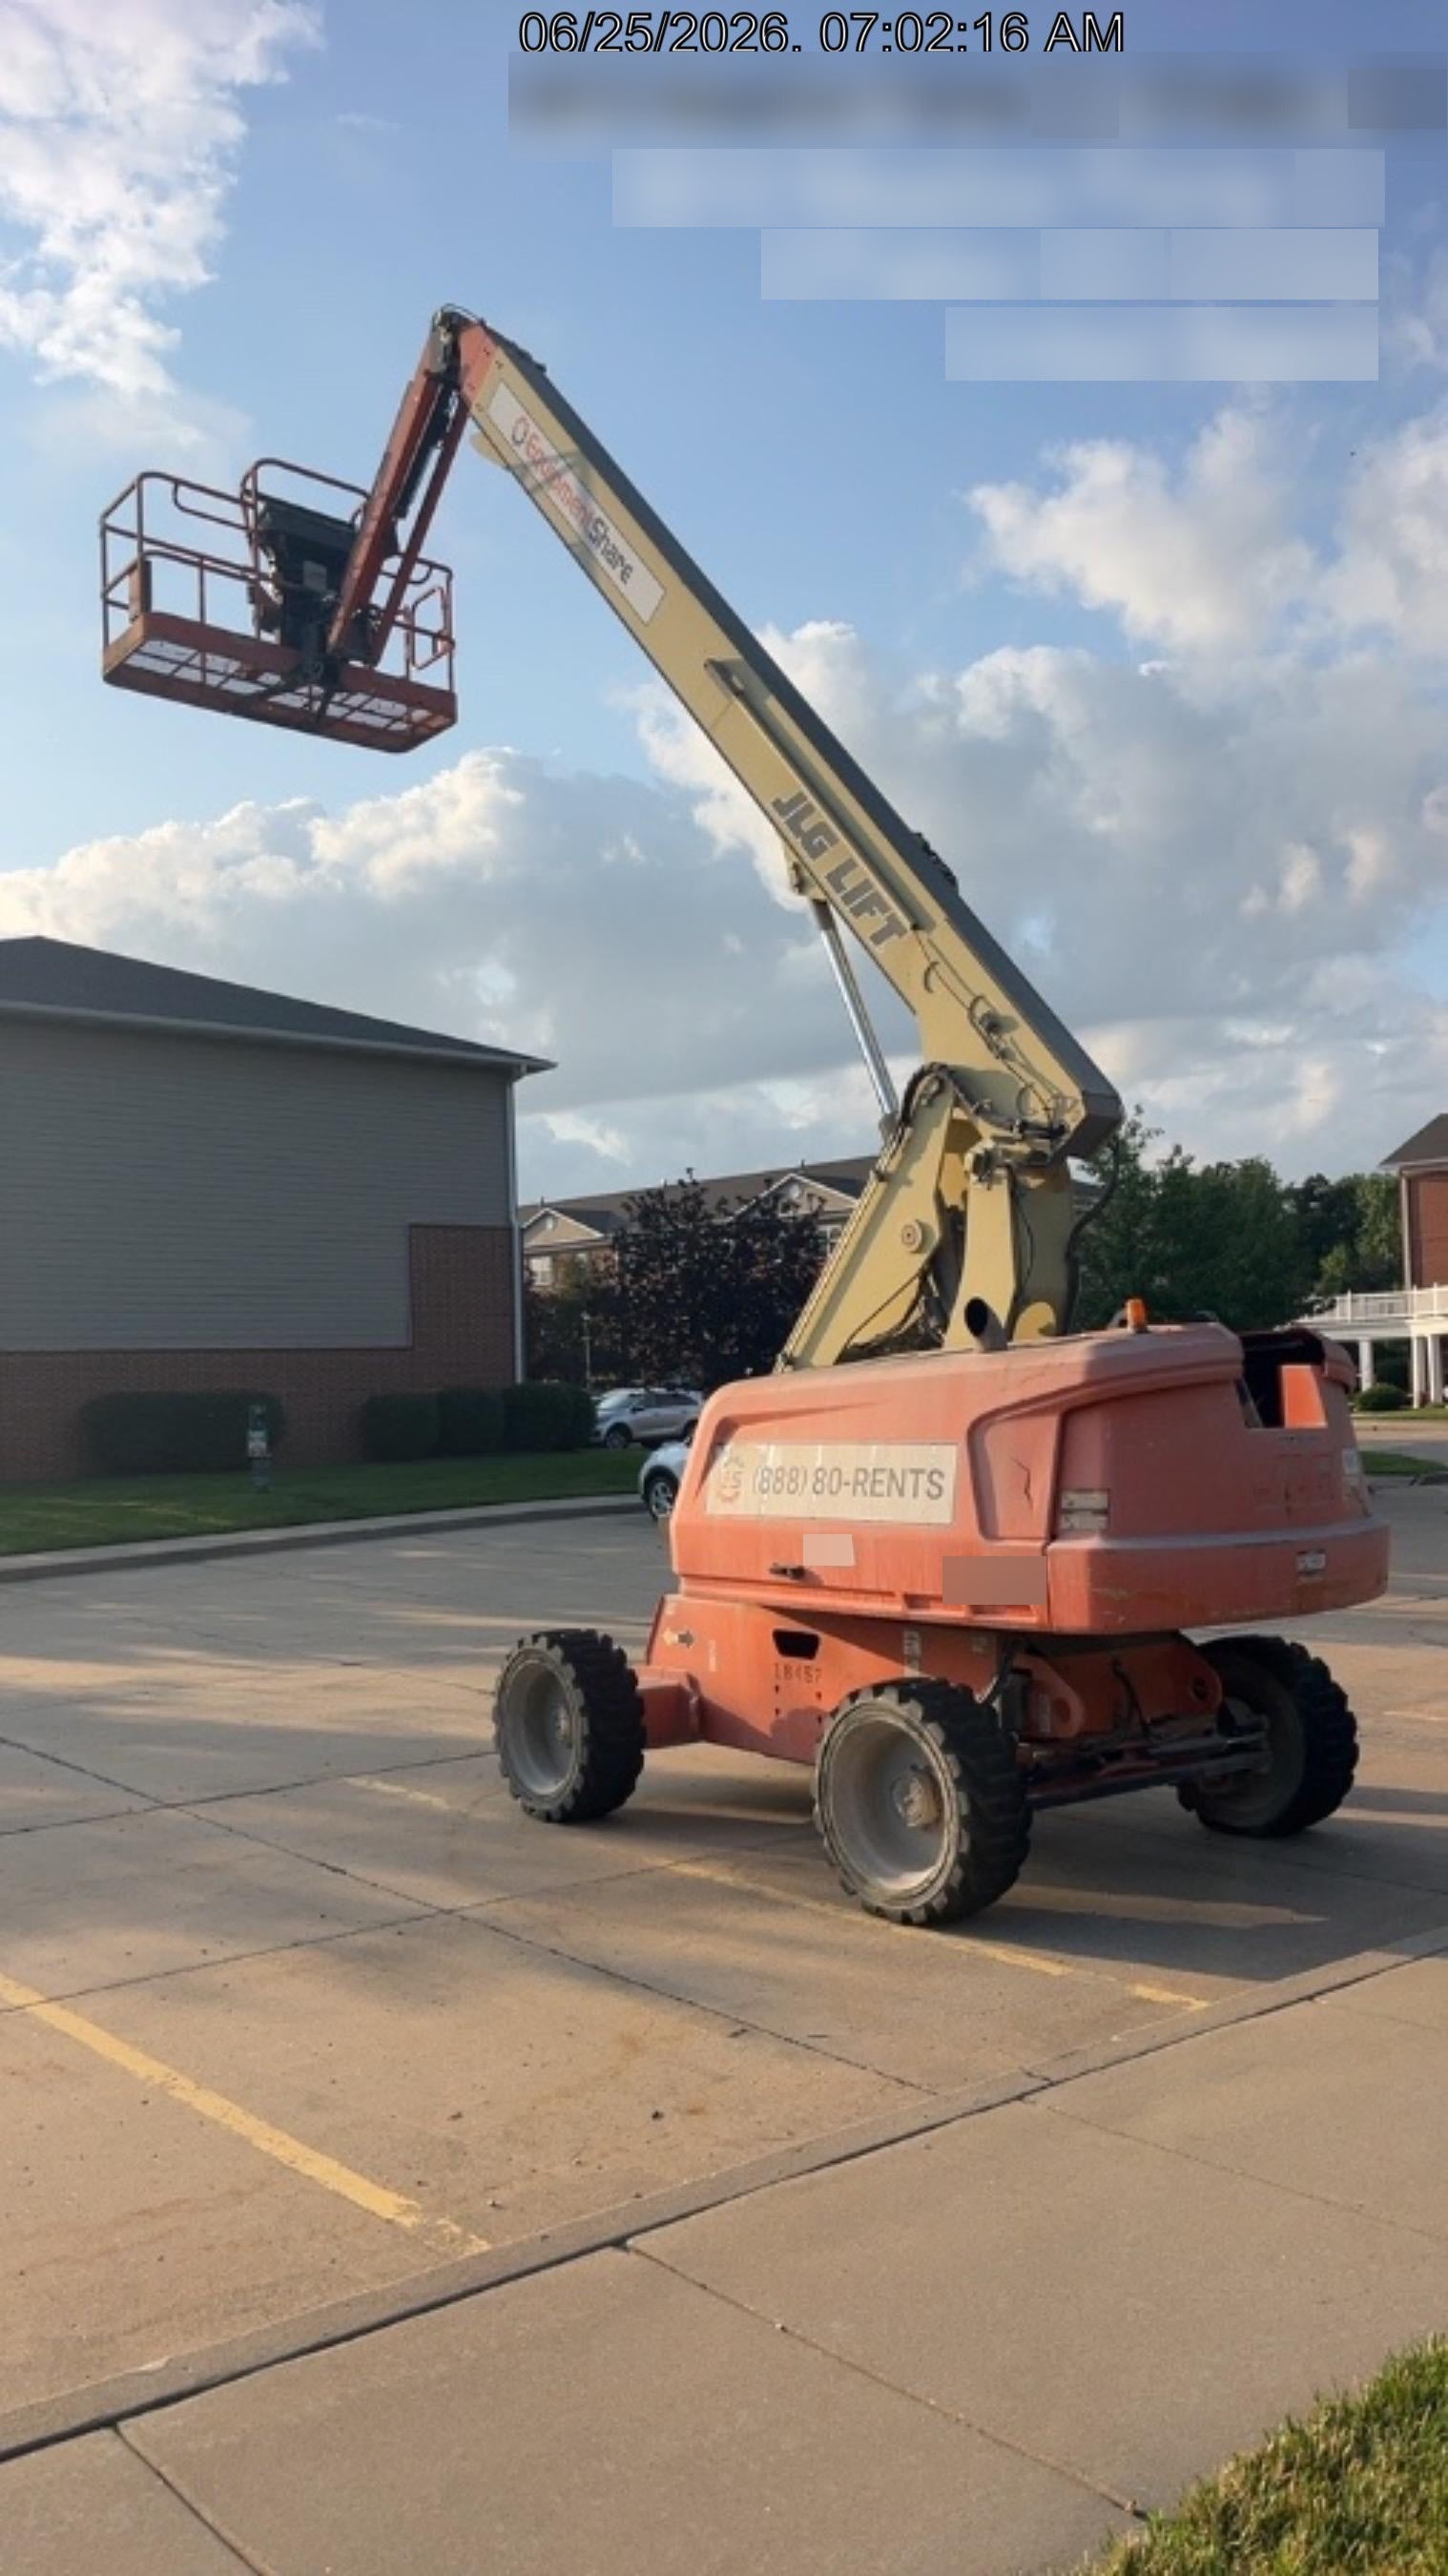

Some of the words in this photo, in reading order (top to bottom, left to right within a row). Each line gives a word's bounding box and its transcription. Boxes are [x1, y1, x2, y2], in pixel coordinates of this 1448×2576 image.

[771, 792, 840, 862] JLG
[825, 858, 910, 945] LIFT
[812, 1466, 946, 1501] 80-RENTS
